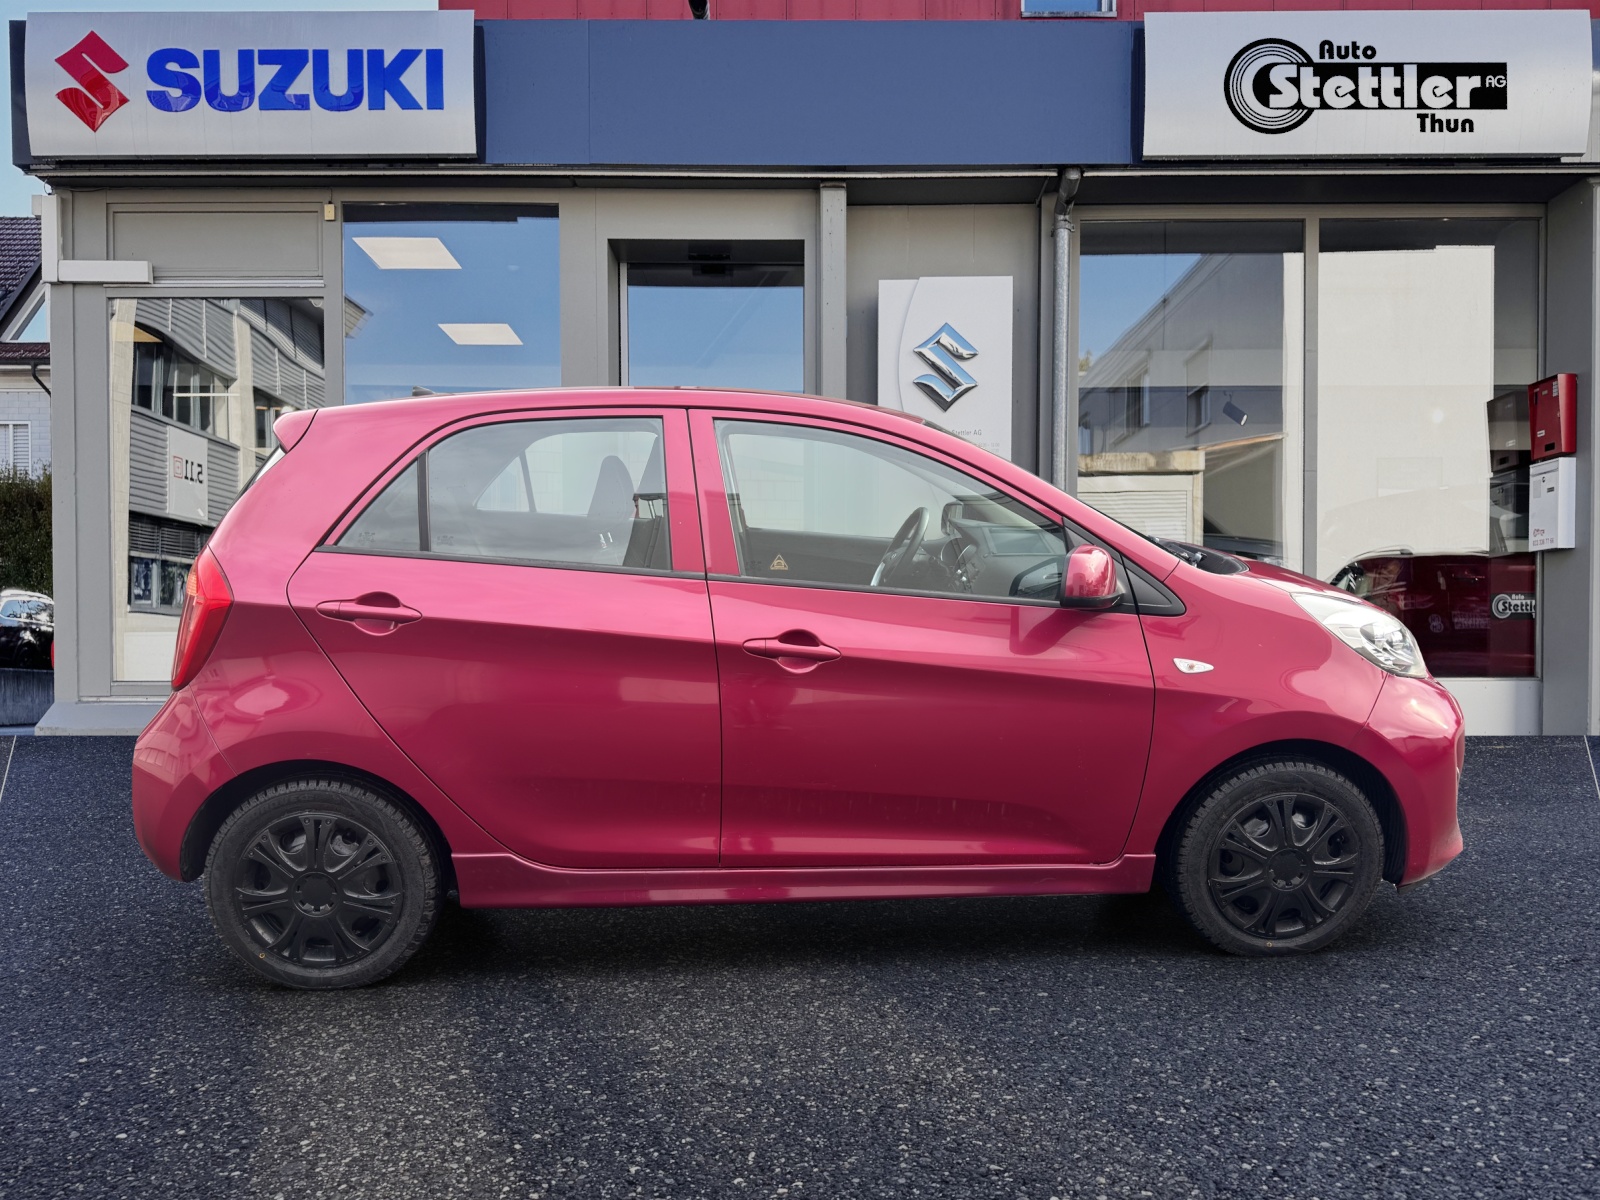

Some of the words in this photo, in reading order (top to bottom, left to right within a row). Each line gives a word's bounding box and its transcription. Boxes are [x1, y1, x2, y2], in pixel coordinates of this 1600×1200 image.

[1319, 40, 1377, 60] Auto
[146, 48, 444, 112] SUZUKI
[1269, 63, 1481, 109] Stettler
[1485, 75, 1507, 88] AG
[1416, 113, 1475, 133] Thun
